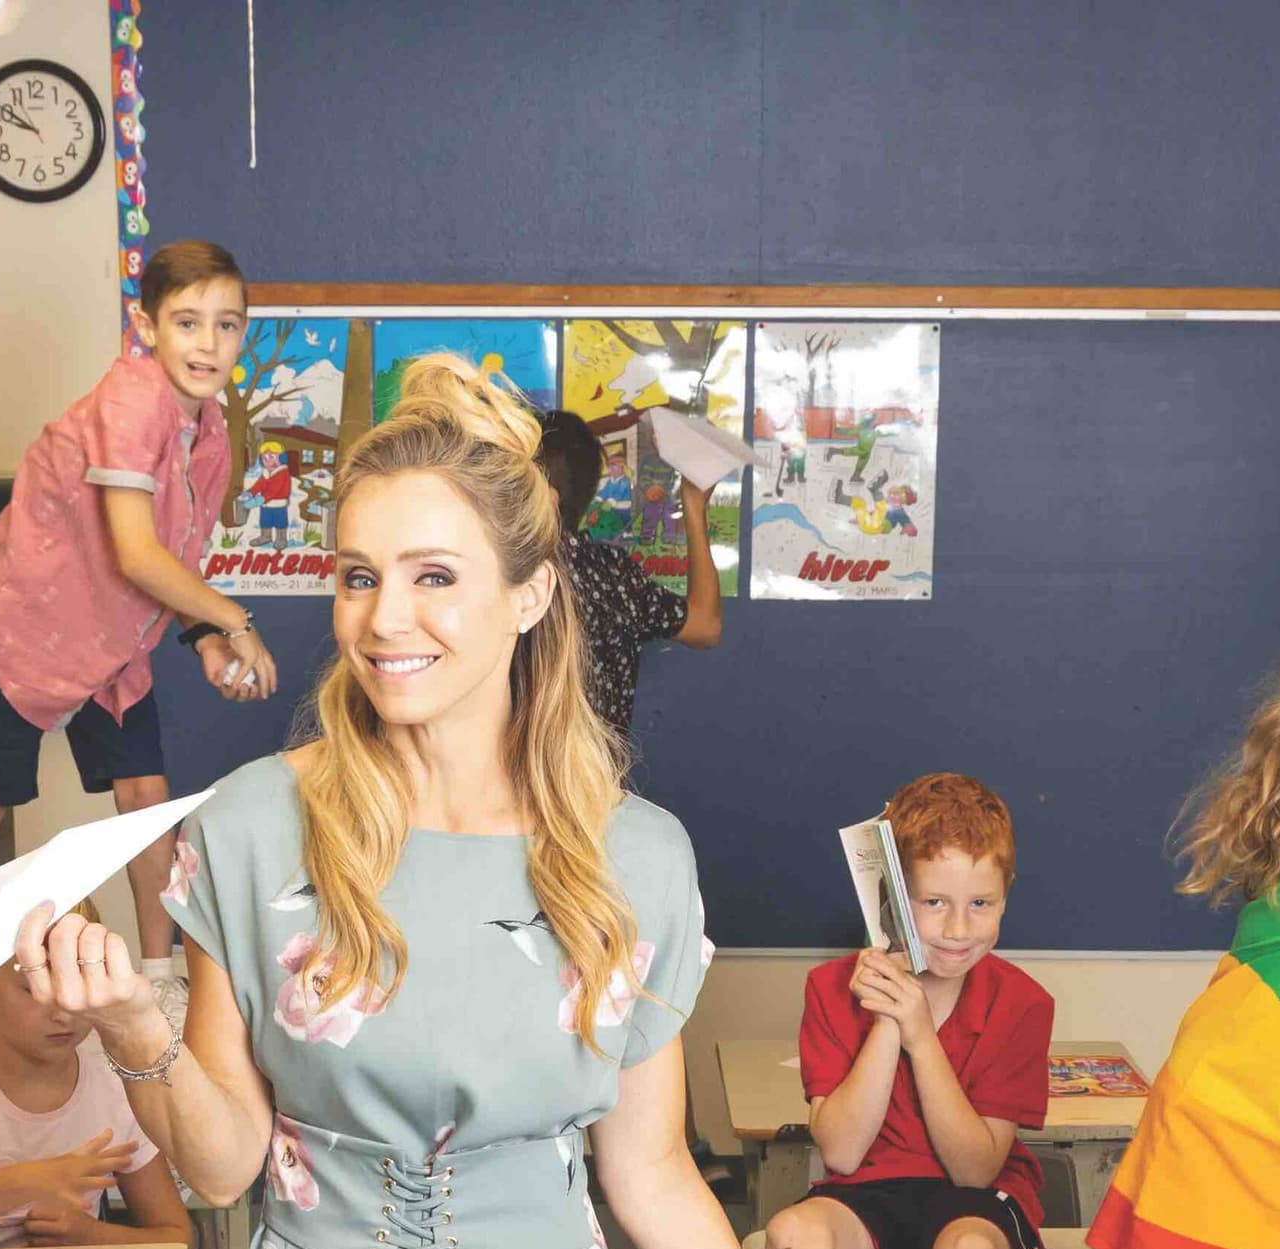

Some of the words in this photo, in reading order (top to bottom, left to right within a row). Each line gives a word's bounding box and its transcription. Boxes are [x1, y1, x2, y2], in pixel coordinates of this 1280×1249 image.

[10, 87, 23, 106] 11
[26, 79, 45, 99] 12
[65, 100, 77, 118] 2
[72, 122, 84, 140] 3
[0, 143, 11, 162] 8
[65, 143, 78, 160] 4
[16, 158, 26, 177] 7
[33, 164, 46, 182] 6
[53, 157, 65, 175] 5
[799, 551, 891, 582] hiver
